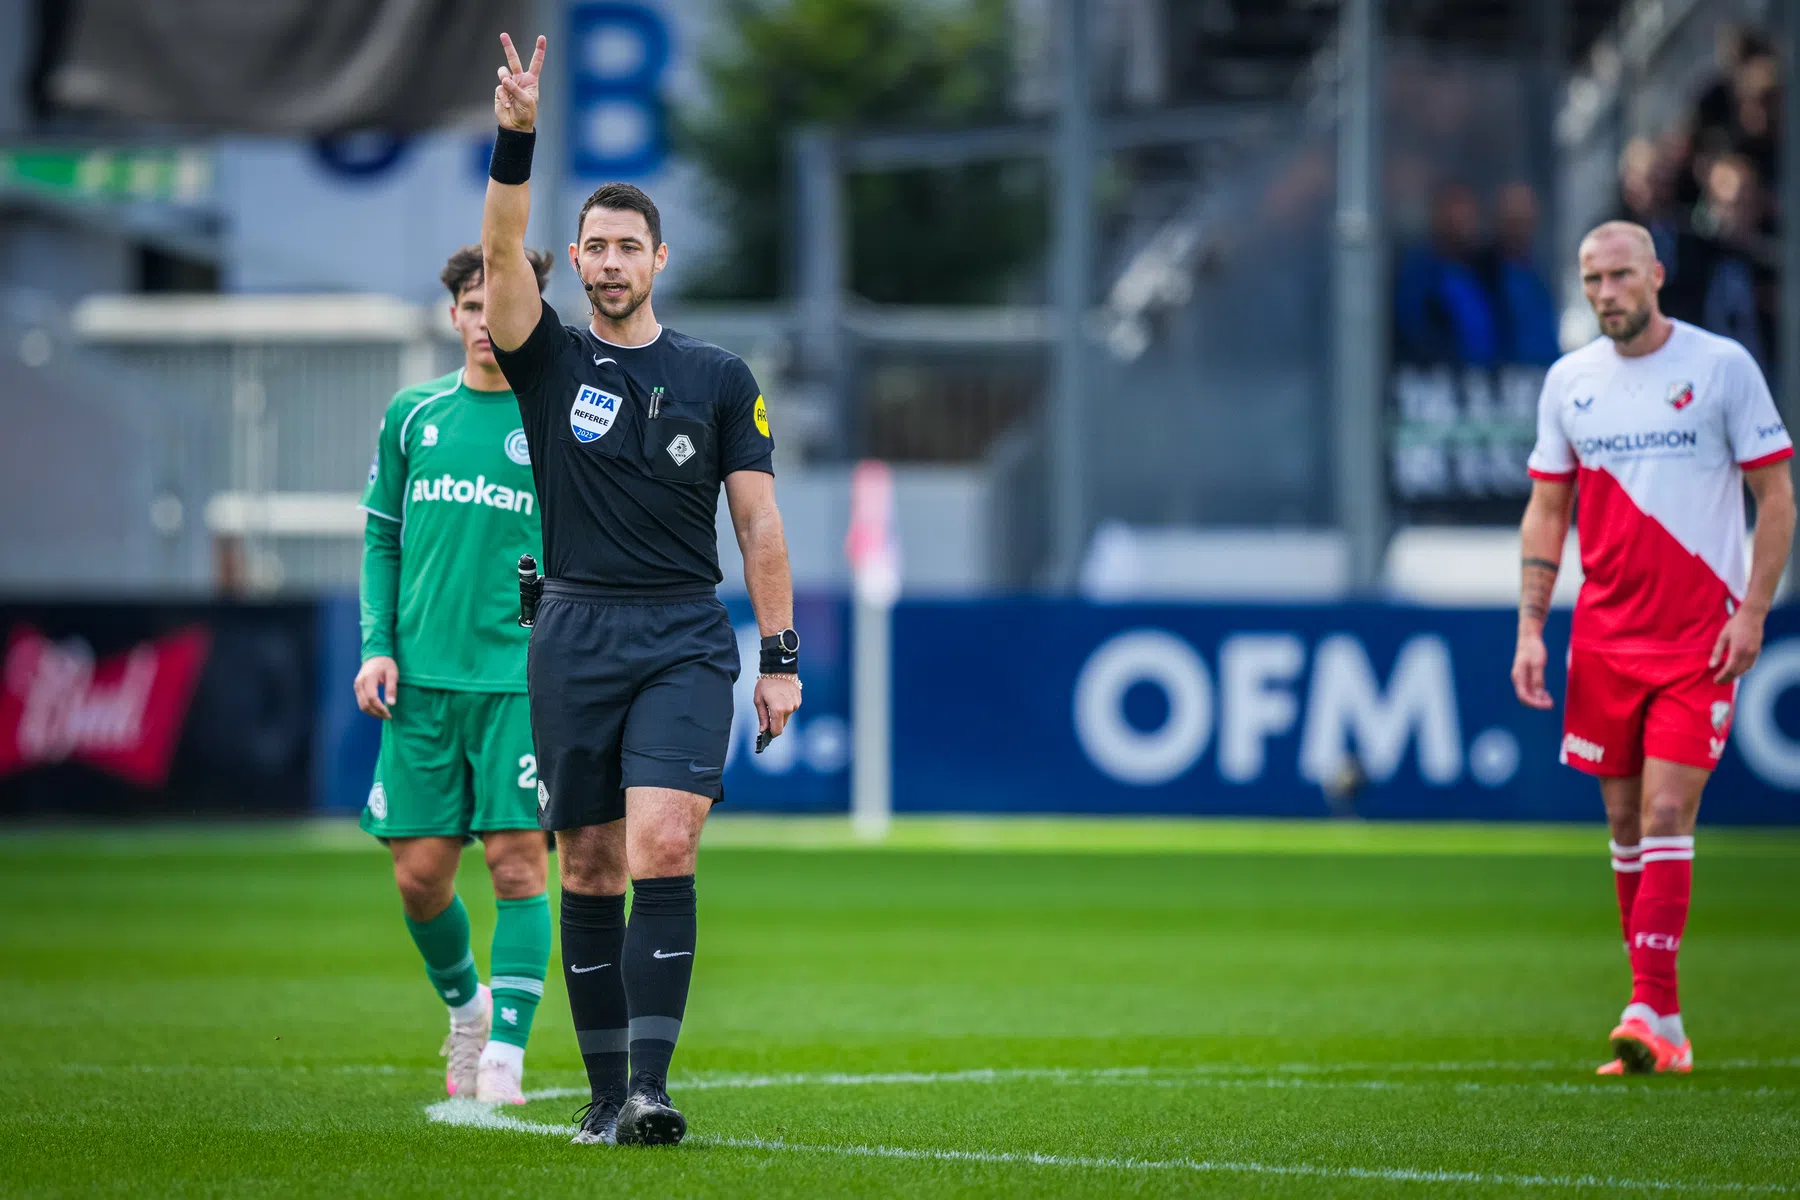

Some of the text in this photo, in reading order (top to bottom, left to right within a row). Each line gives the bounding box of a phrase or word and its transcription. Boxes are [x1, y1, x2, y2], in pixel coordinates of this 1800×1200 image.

[580, 388, 615, 413] FIFA
[574, 408, 610, 427] REFEREE
[757, 407, 768, 423] AR
[576, 428, 594, 440] 2025
[412, 473, 534, 516] autokan
[1073, 627, 1520, 787] OFM.
